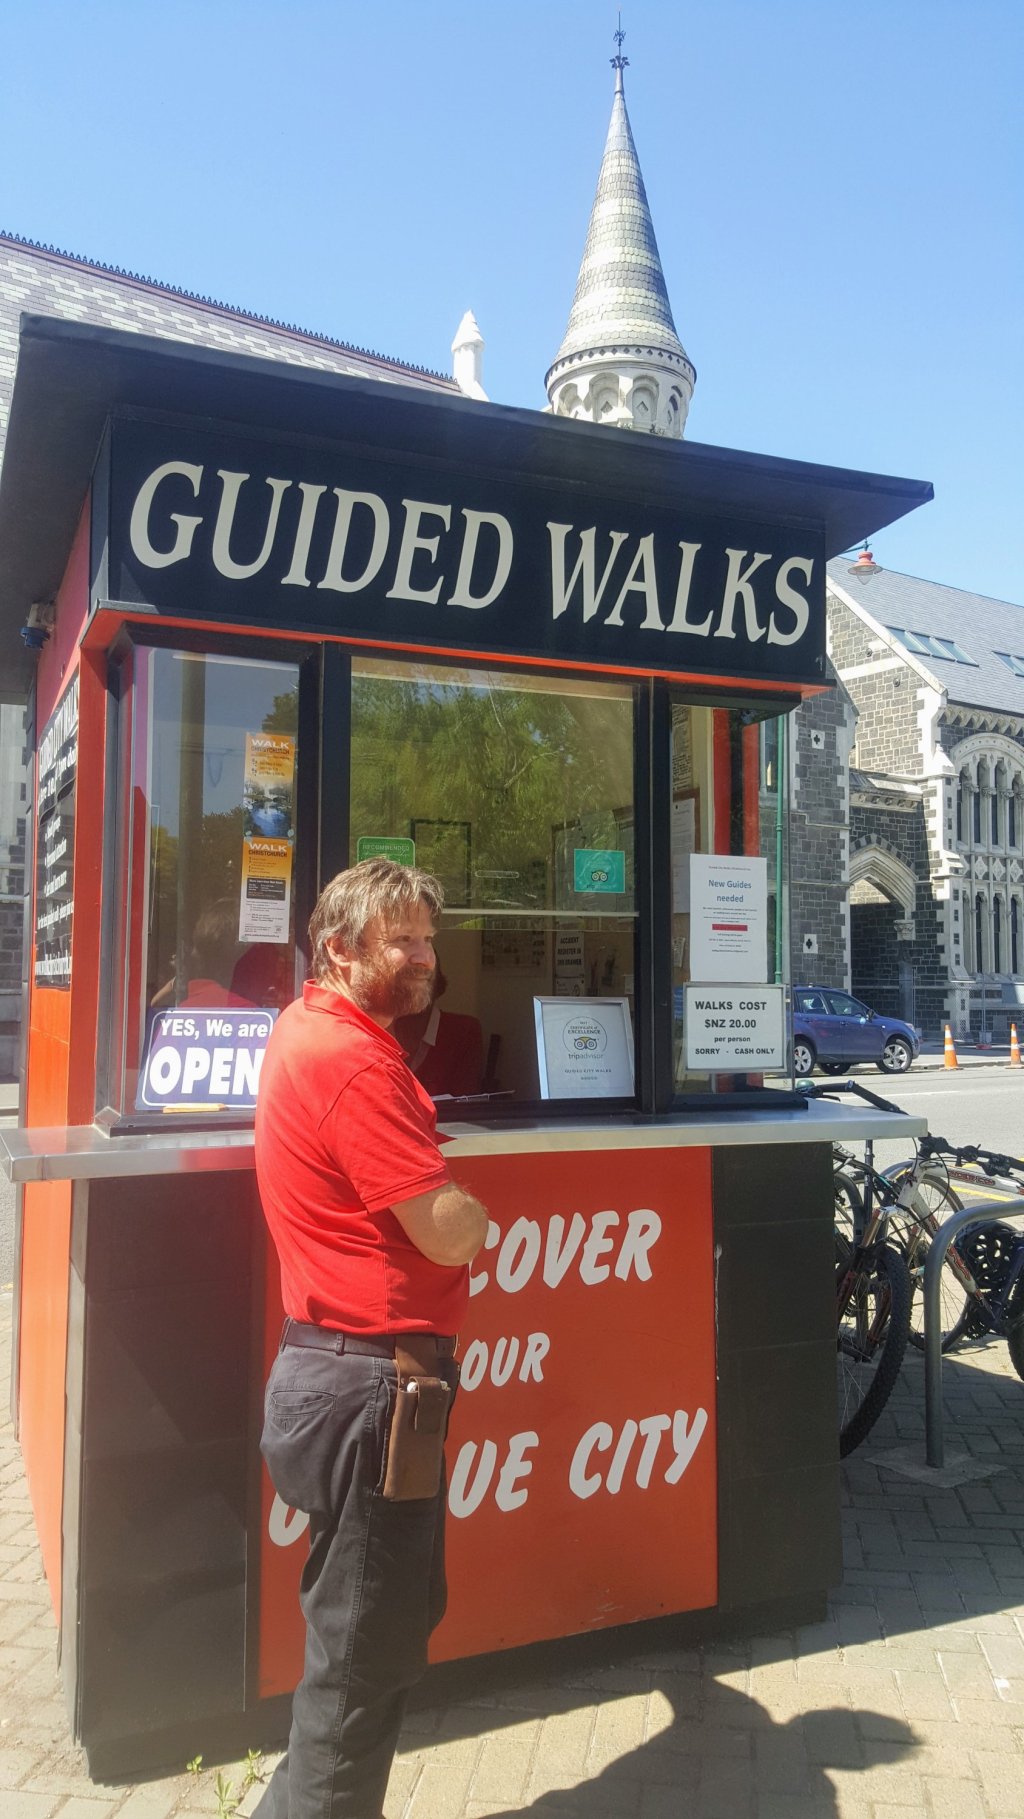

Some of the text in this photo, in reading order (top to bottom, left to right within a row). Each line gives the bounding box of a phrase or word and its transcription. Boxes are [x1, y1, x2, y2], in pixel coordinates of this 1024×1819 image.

[130, 461, 814, 646] GUIDED WALKS
[251, 738, 290, 750] WALK
[249, 842, 288, 852] WALK
[248, 849, 288, 858] CHRISTCHURCH
[708, 879, 752, 889] New Guides
[716, 894, 744, 903] needed
[695, 1001, 767, 1011] WALKS COST
[704, 1019, 757, 1029] $NZ 20.00
[160, 1019, 268, 1040] YES, We are
[568, 1052, 604, 1060] tripadvisor
[149, 1046, 266, 1095] OPEN
[459, 1332, 550, 1391] OUR
[569, 1407, 708, 1499] CITY
